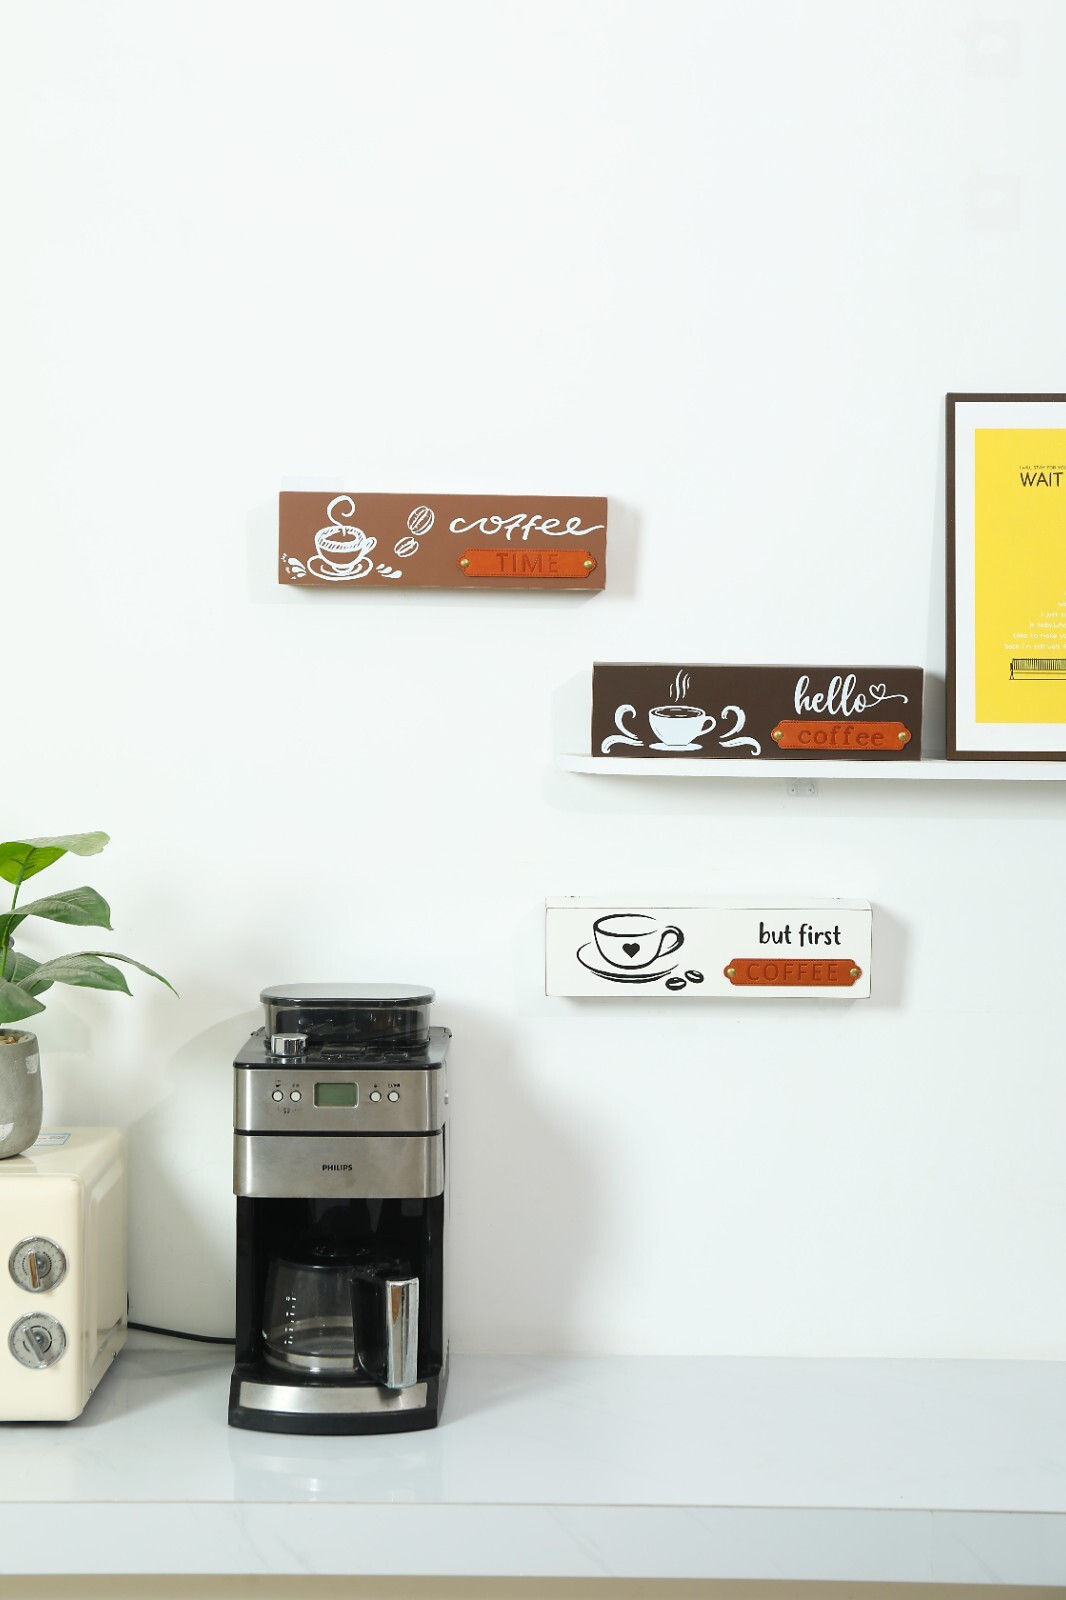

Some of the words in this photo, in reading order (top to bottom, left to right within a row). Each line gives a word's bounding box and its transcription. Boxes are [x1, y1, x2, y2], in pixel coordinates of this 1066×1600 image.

[1020, 471, 1064, 487] WAIT
[449, 514, 605, 541] coffee
[495, 552, 559, 574] TIME
[794, 674, 868, 717] hello
[797, 725, 885, 748] coffee
[758, 921, 792, 945] but
[798, 923, 841, 947] first
[747, 963, 838, 981] COFFEE
[322, 1164, 353, 1172] PHILIPS
